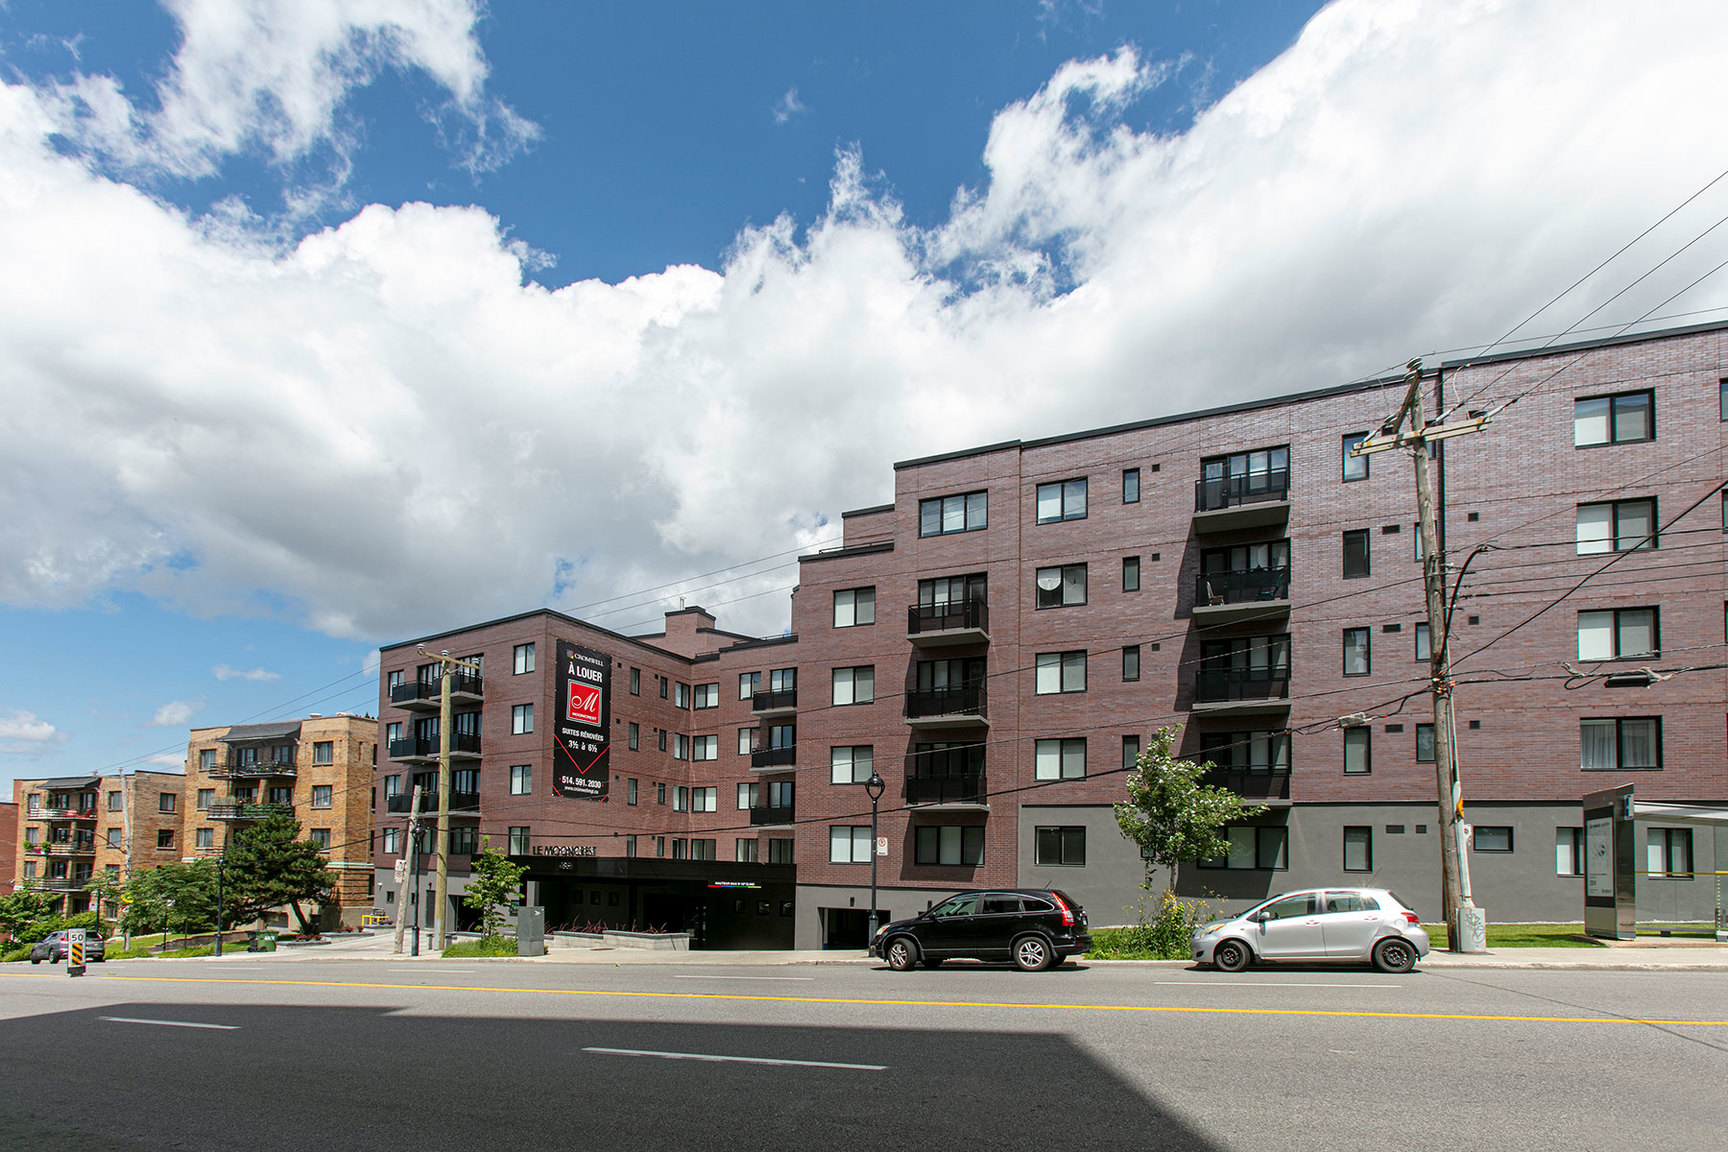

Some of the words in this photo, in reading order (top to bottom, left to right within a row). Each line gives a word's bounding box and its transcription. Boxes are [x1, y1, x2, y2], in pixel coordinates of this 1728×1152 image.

[574, 653, 604, 667] CROMWELL
[568, 661, 575, 675] À
[576, 665, 603, 683] LOUER
[562, 727, 580, 737] SUITES
[580, 730, 604, 742] RÉNOVÉES
[532, 846, 543, 855] LE
[544, 845, 597, 856] MOONCREST
[72, 933, 84, 942] 50
